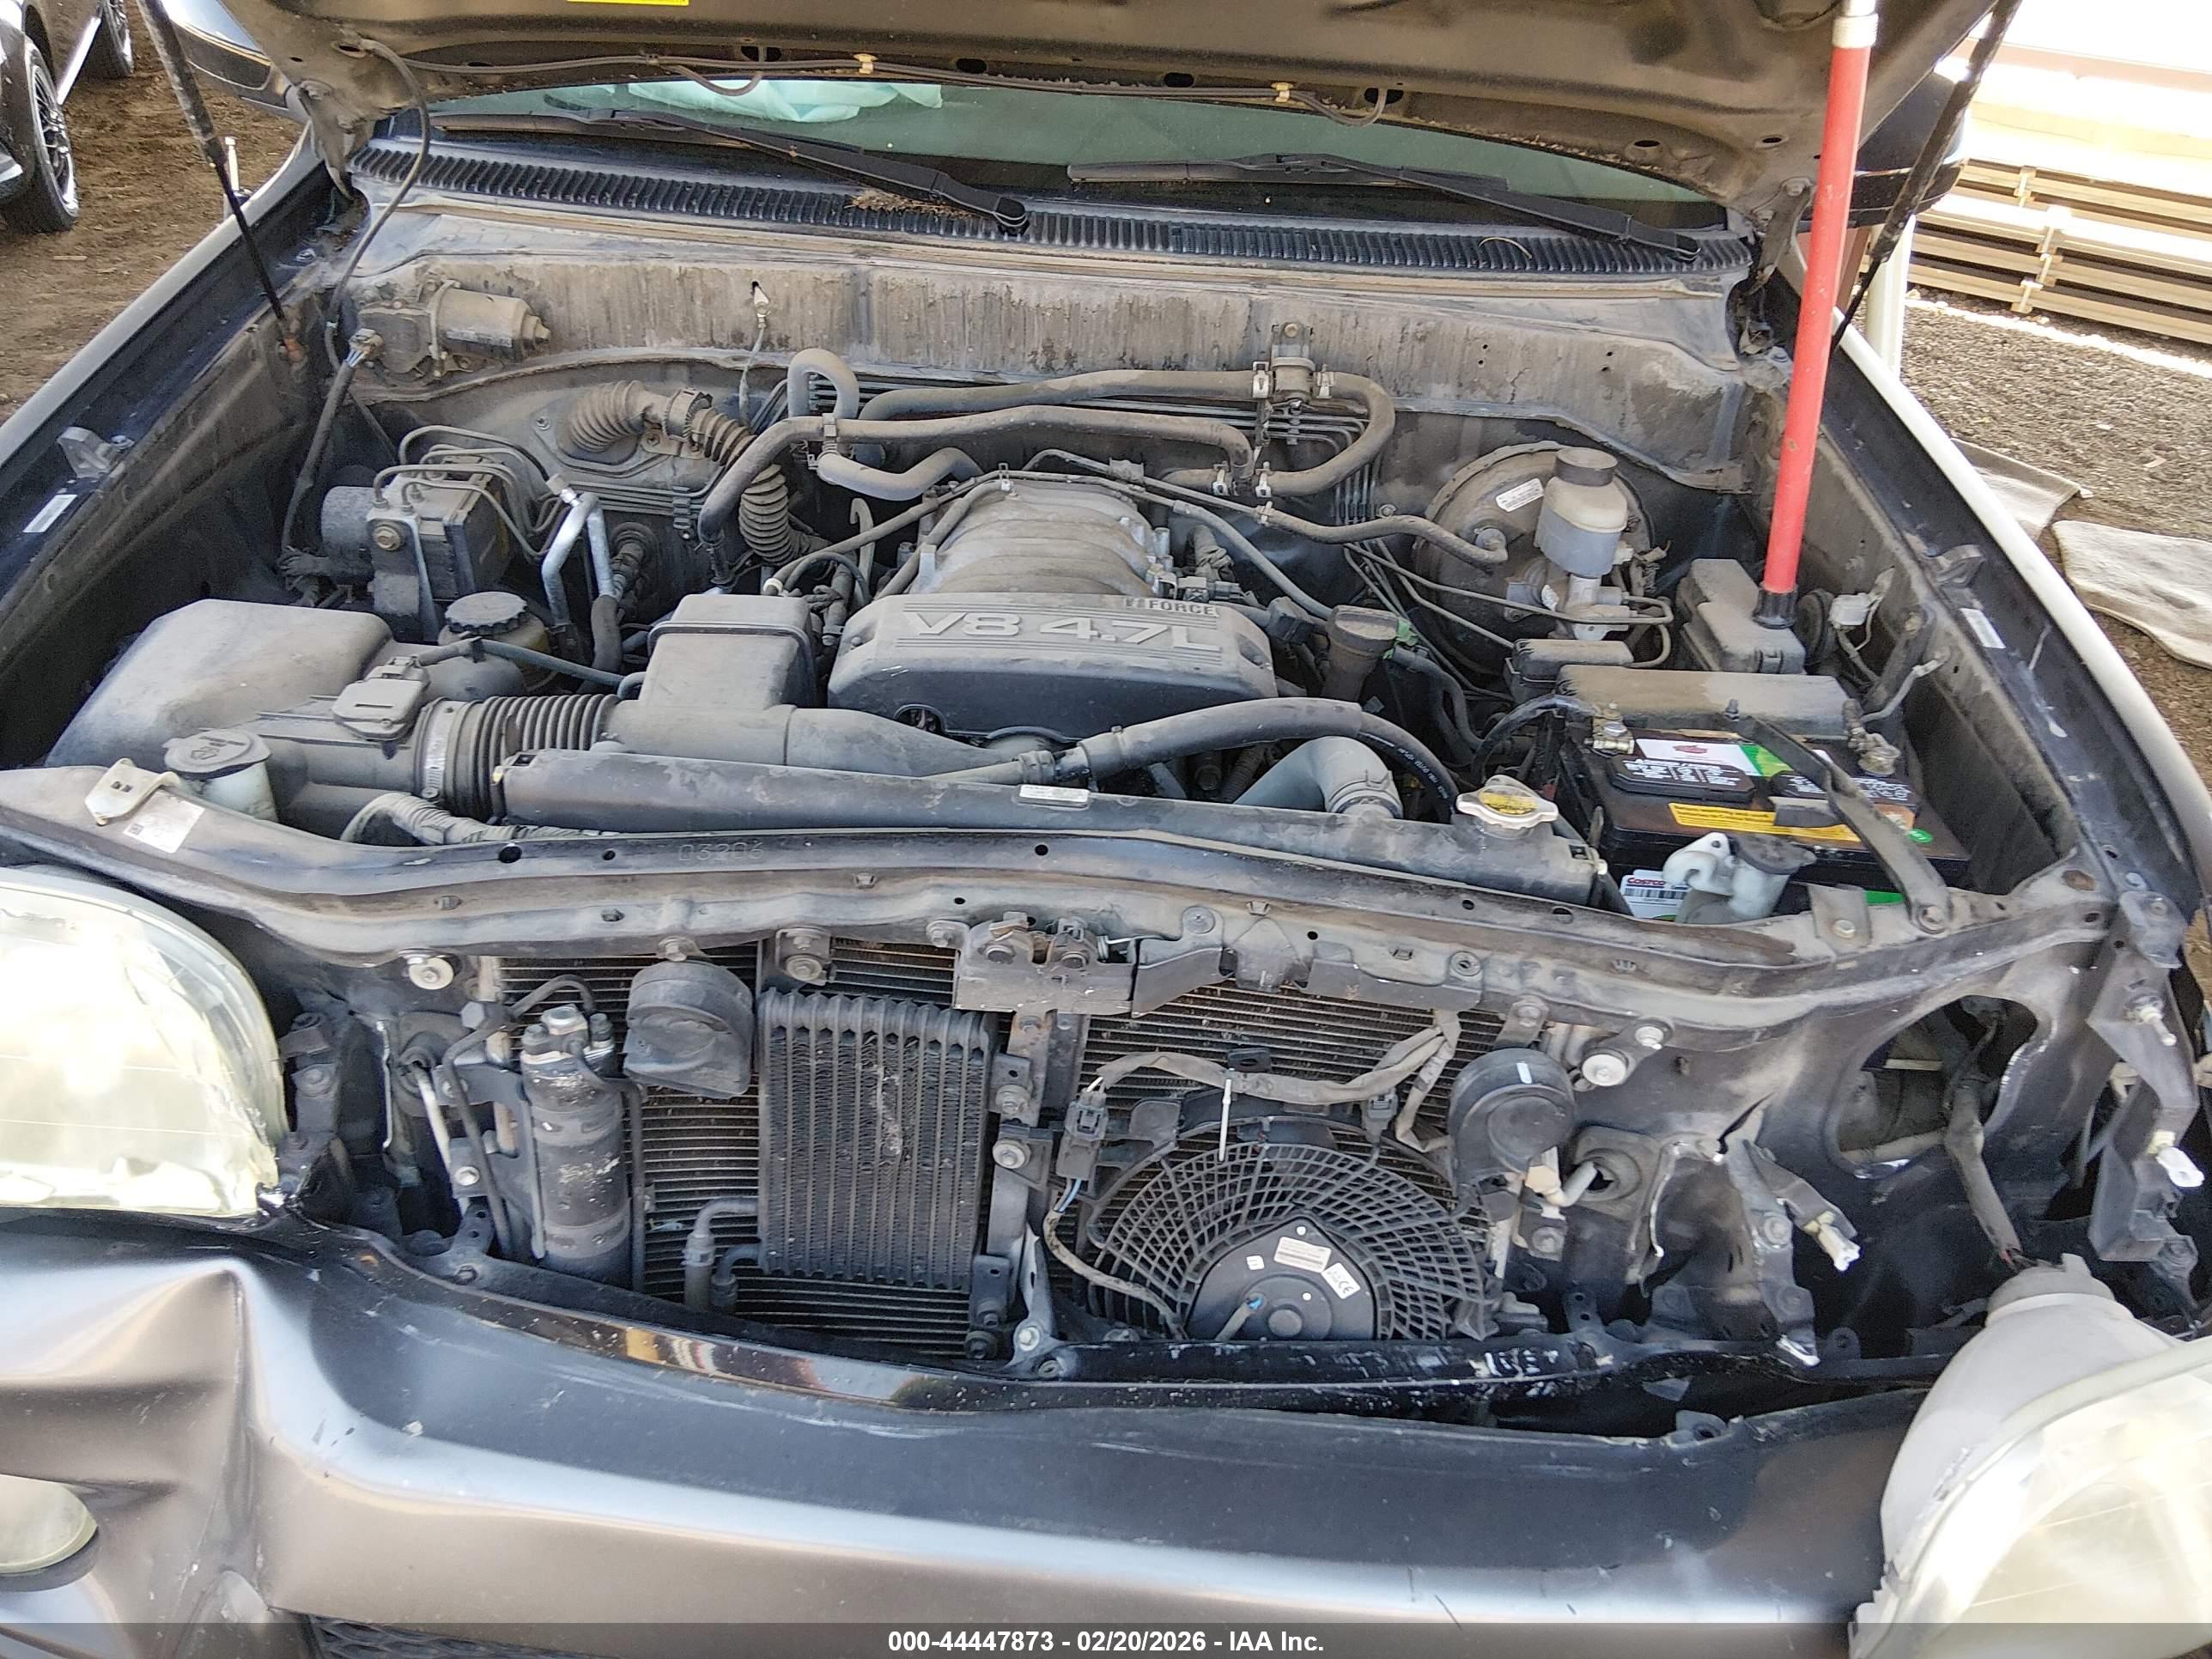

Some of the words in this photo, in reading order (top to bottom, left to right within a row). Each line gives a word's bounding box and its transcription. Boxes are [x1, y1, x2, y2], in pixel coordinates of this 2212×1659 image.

[1148, 599, 1216, 616] FORCE
[902, 611, 1022, 637] V8
[1040, 617, 1223, 653] 4.7L
